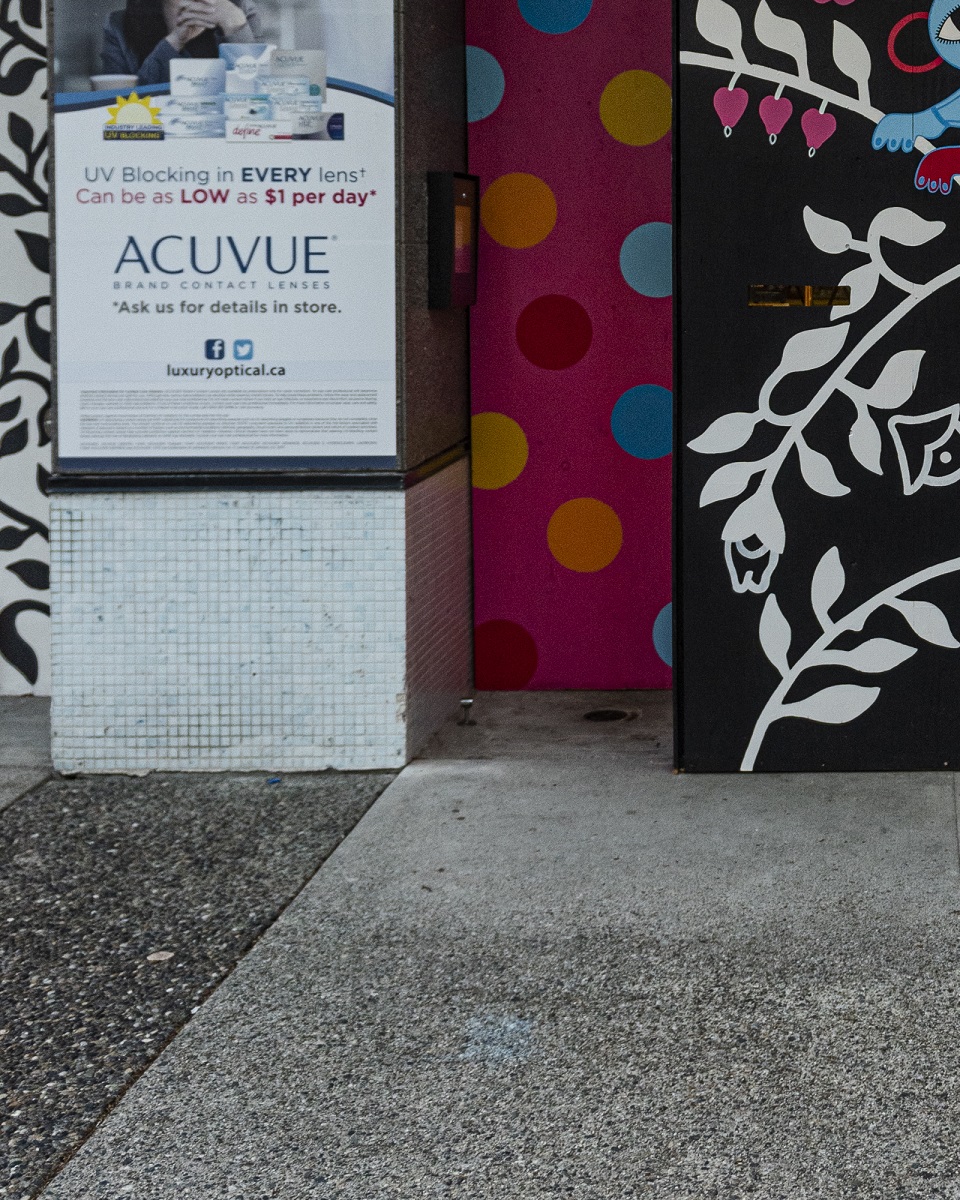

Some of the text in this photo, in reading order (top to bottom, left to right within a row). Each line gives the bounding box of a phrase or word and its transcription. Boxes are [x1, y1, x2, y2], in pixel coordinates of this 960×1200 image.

[85, 167, 114, 182] UV
[122, 167, 209, 185] Blocking
[217, 167, 234, 182] in
[242, 167, 312, 182] EVERY
[76, 188, 114, 204] Can
[122, 188, 146, 204] be
[152, 192, 173, 204] as
[181, 189, 230, 203] LOW
[237, 192, 258, 204] as
[265, 188, 285, 205] $1
[292, 192, 326, 207] per
[113, 281, 330, 290] BRAND CONTACT LENSES
[156, 303, 174, 314] us
[180, 301, 204, 314] for
[210, 301, 267, 314] details
[273, 301, 289, 314] in
[294, 301, 342, 314] store.
[166, 364, 286, 379] luxuryoptical.ca
